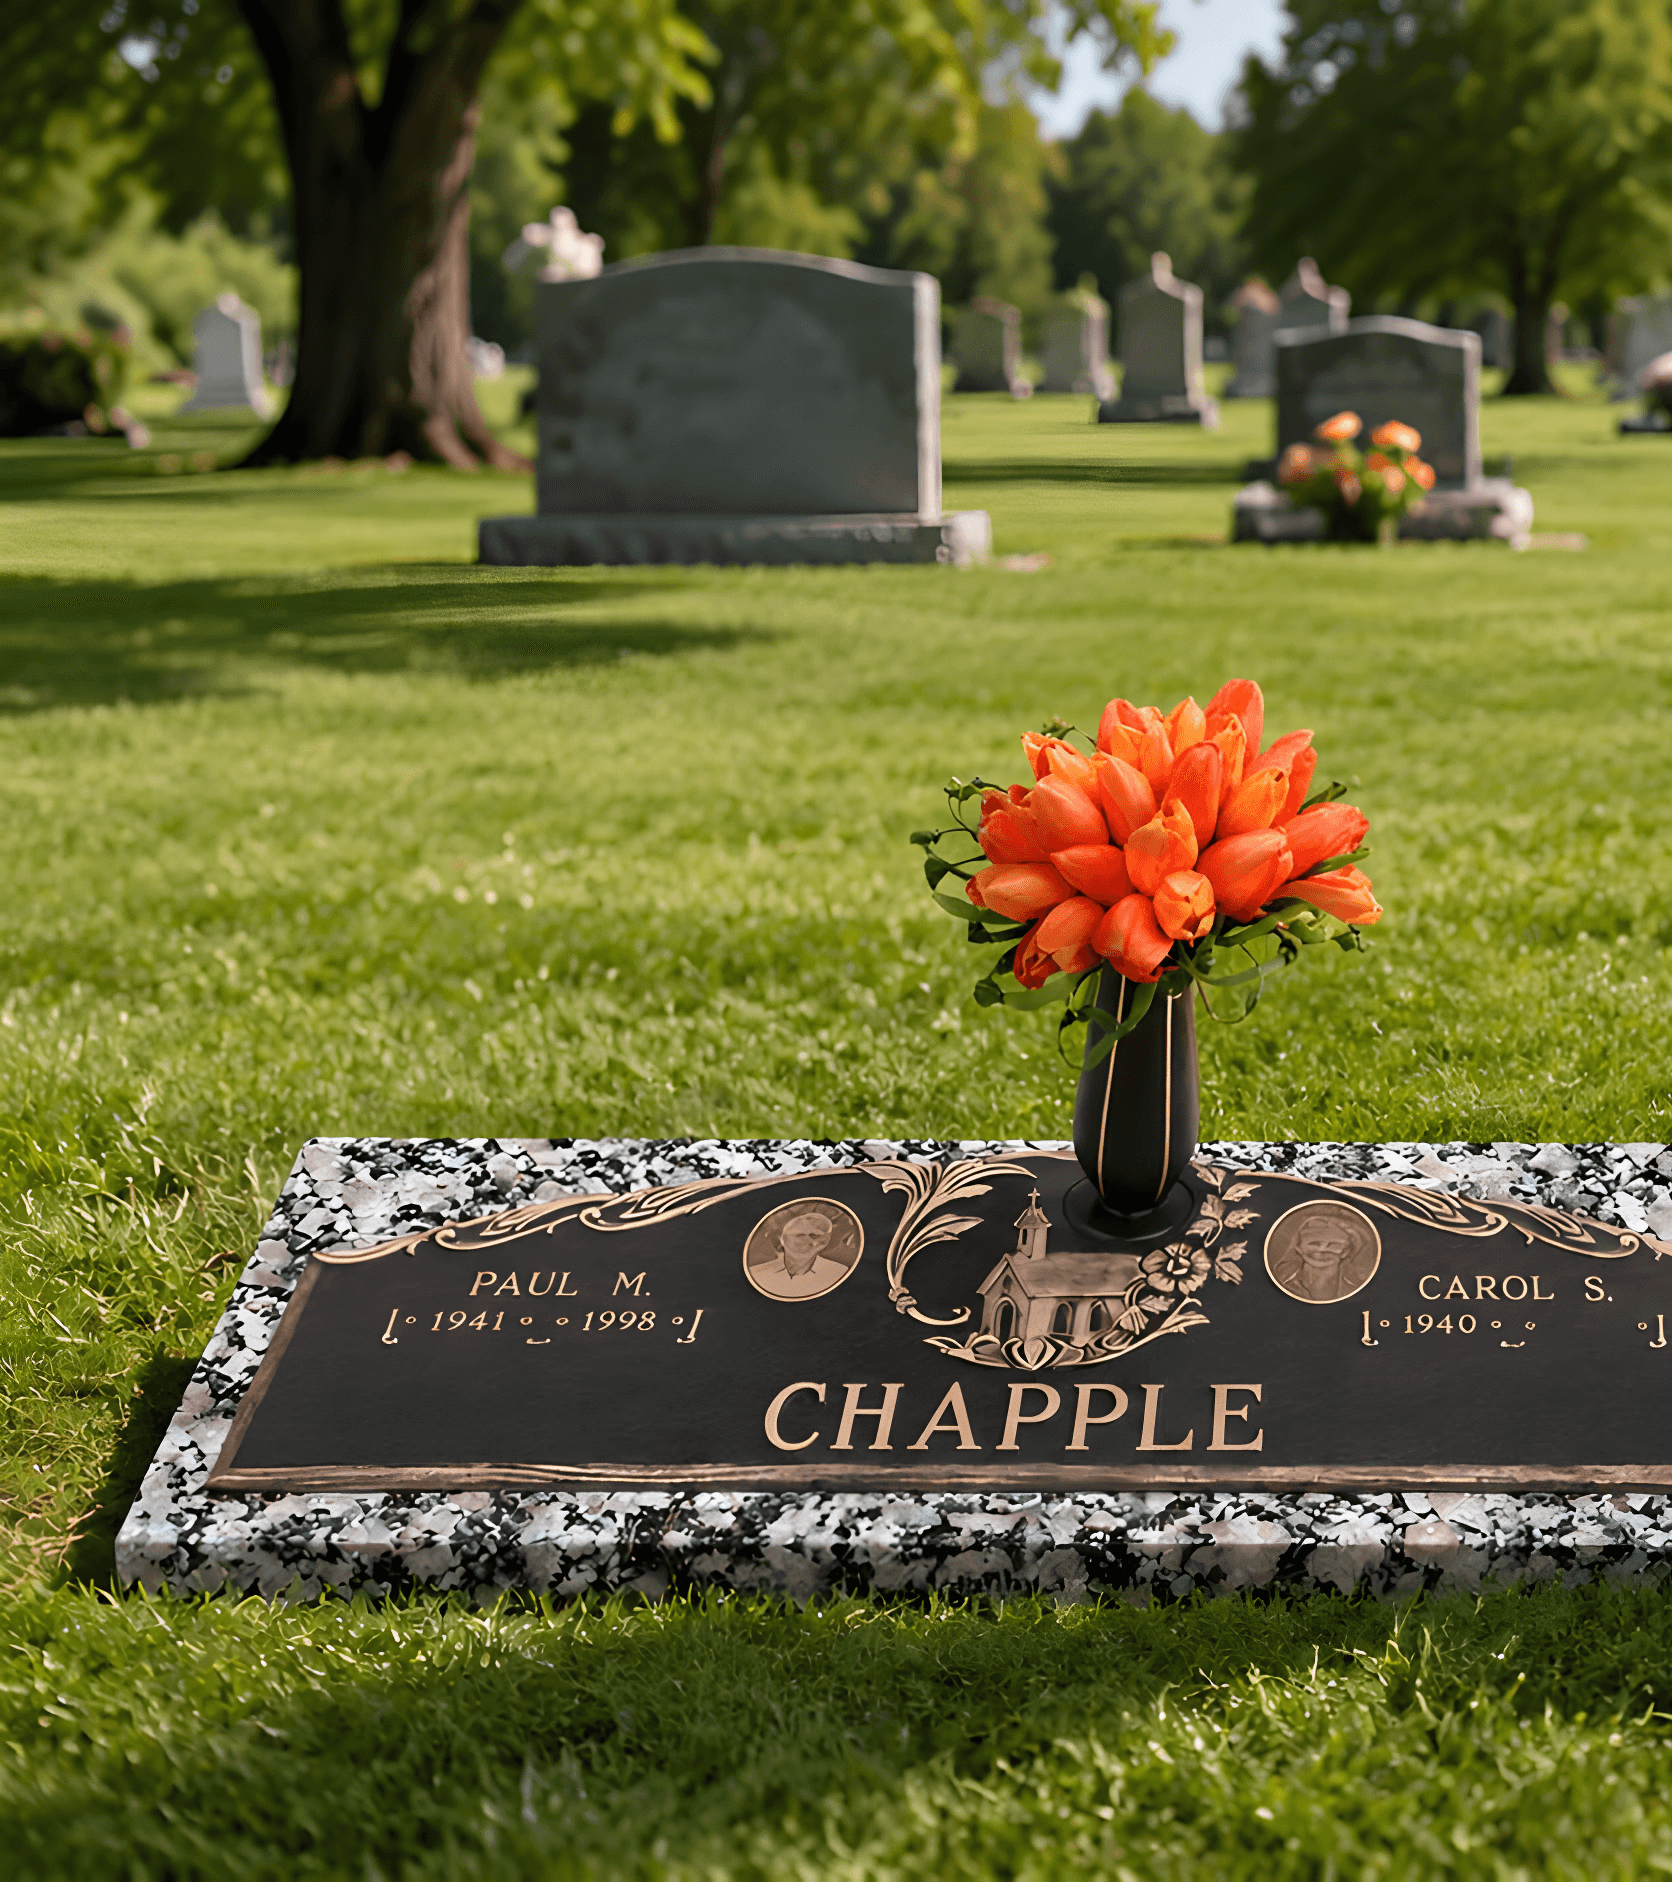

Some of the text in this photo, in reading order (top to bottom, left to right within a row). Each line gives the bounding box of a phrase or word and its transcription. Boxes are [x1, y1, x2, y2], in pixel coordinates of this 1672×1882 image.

[469, 1271, 651, 1296] PAUL M.
[1418, 1275, 1613, 1302] CAROL S.
[430, 1310, 656, 1331] 1941 1998
[1404, 1314, 1477, 1334] 1940
[764, 1381, 1263, 1452] CHAPPLE
